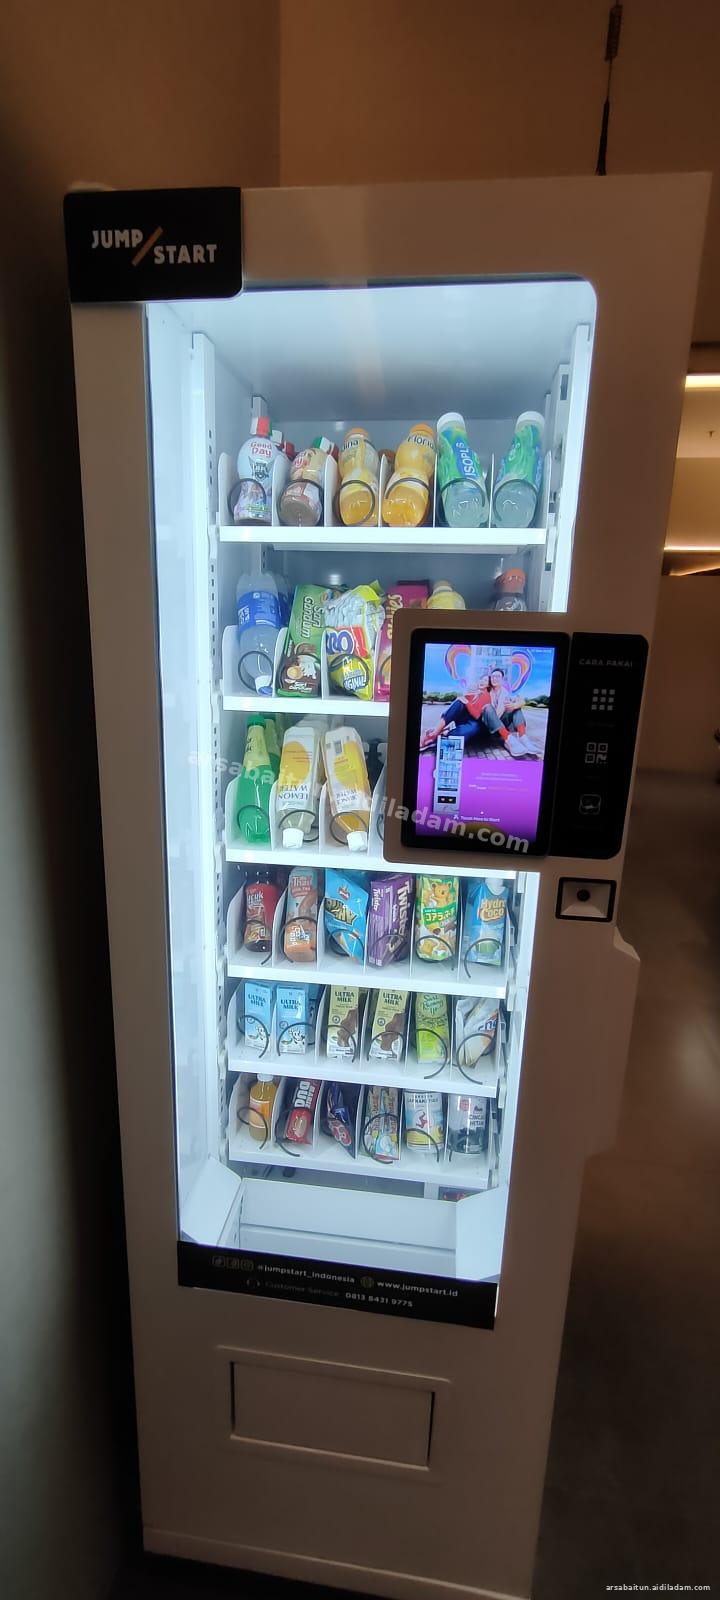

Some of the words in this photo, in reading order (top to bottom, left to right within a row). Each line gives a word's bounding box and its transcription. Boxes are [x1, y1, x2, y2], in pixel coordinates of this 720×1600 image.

[91, 228, 144, 249] JUMP
[153, 244, 218, 265] START
[300, 596, 315, 639] Gandum
[278, 791, 309, 800] LEMON
[248, 993, 267, 1003] ULTRA
[382, 992, 403, 1001] ULTRA
[384, 998, 400, 1006] MILK
[377, 1281, 459, 1298] www.jumpstart.id
